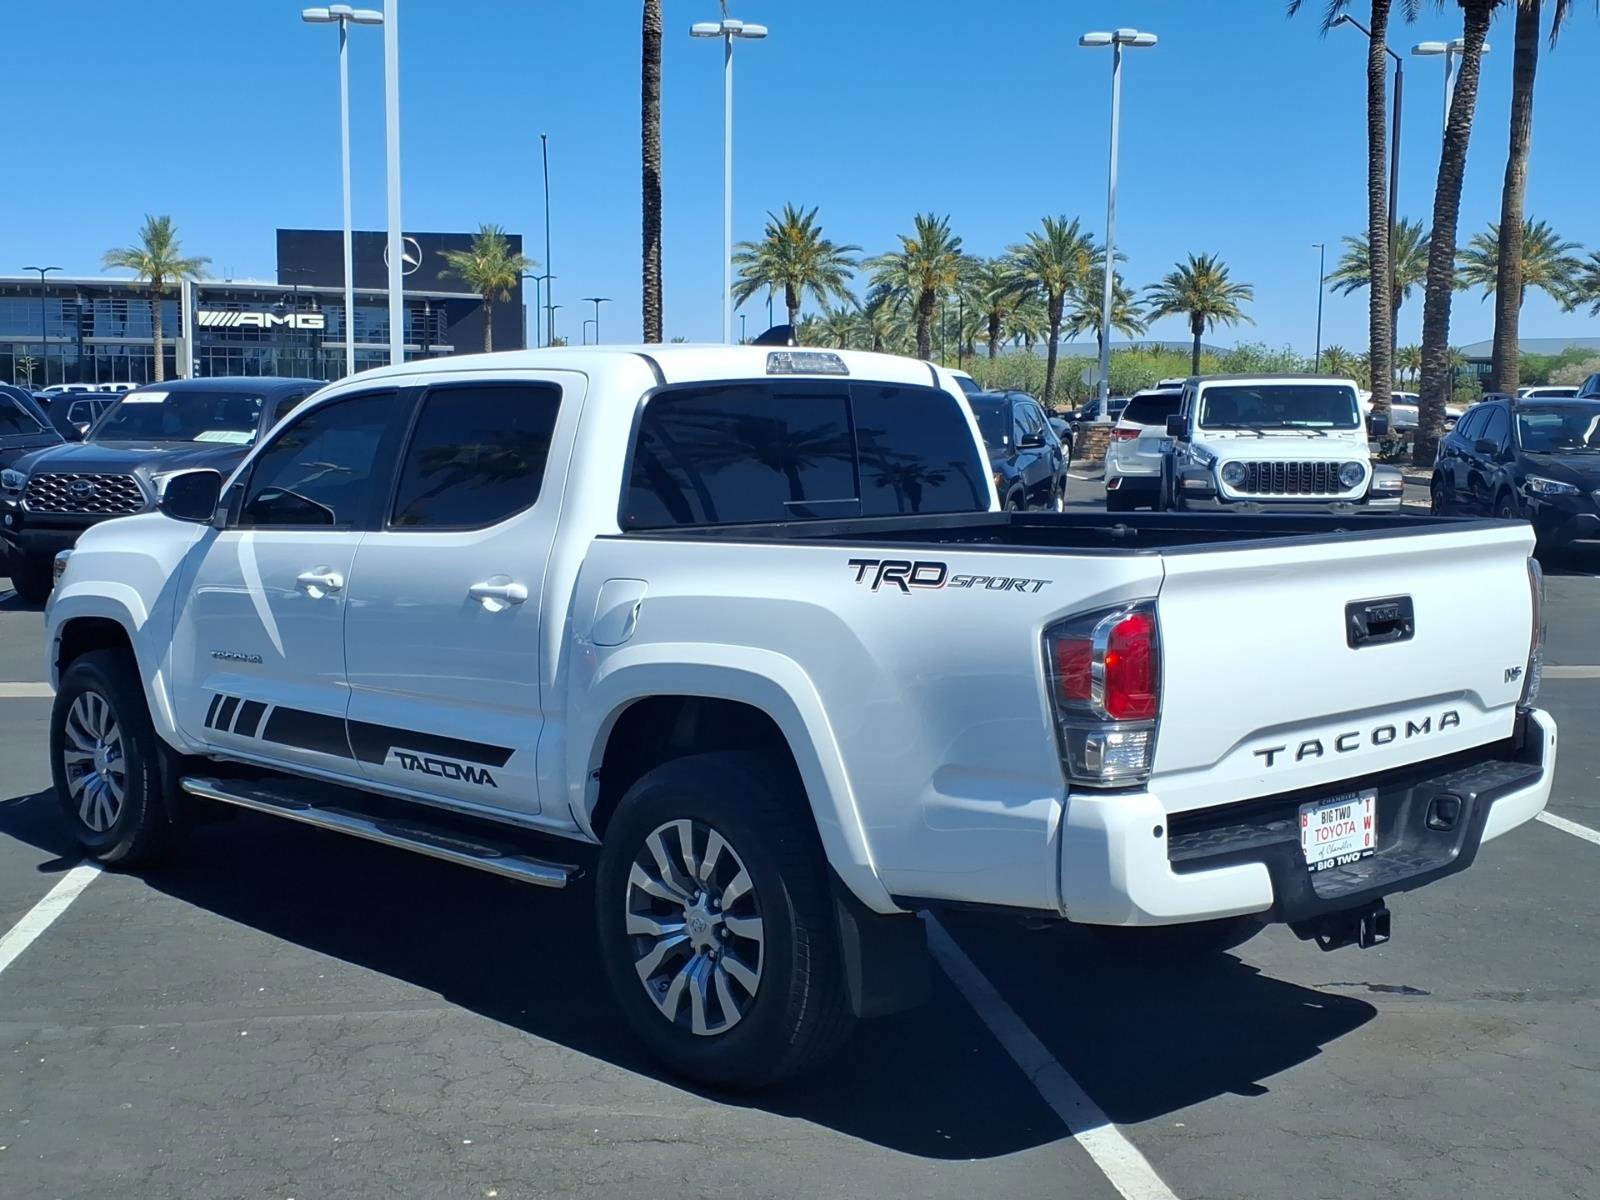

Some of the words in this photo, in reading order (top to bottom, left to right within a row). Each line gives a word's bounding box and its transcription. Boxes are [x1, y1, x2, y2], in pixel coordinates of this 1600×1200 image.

[232, 312, 324, 329] AMG
[848, 559, 948, 595] TRD
[948, 574, 1053, 593] SPORT
[1253, 710, 1461, 768] TACOMA
[394, 751, 498, 788] TACOMA
[1321, 810, 1334, 825] BIG
[1335, 806, 1351, 820] TWO
[1315, 820, 1356, 842] TOYOTA
[1317, 858, 1335, 871] BIG
[1337, 852, 1361, 865] TWO
